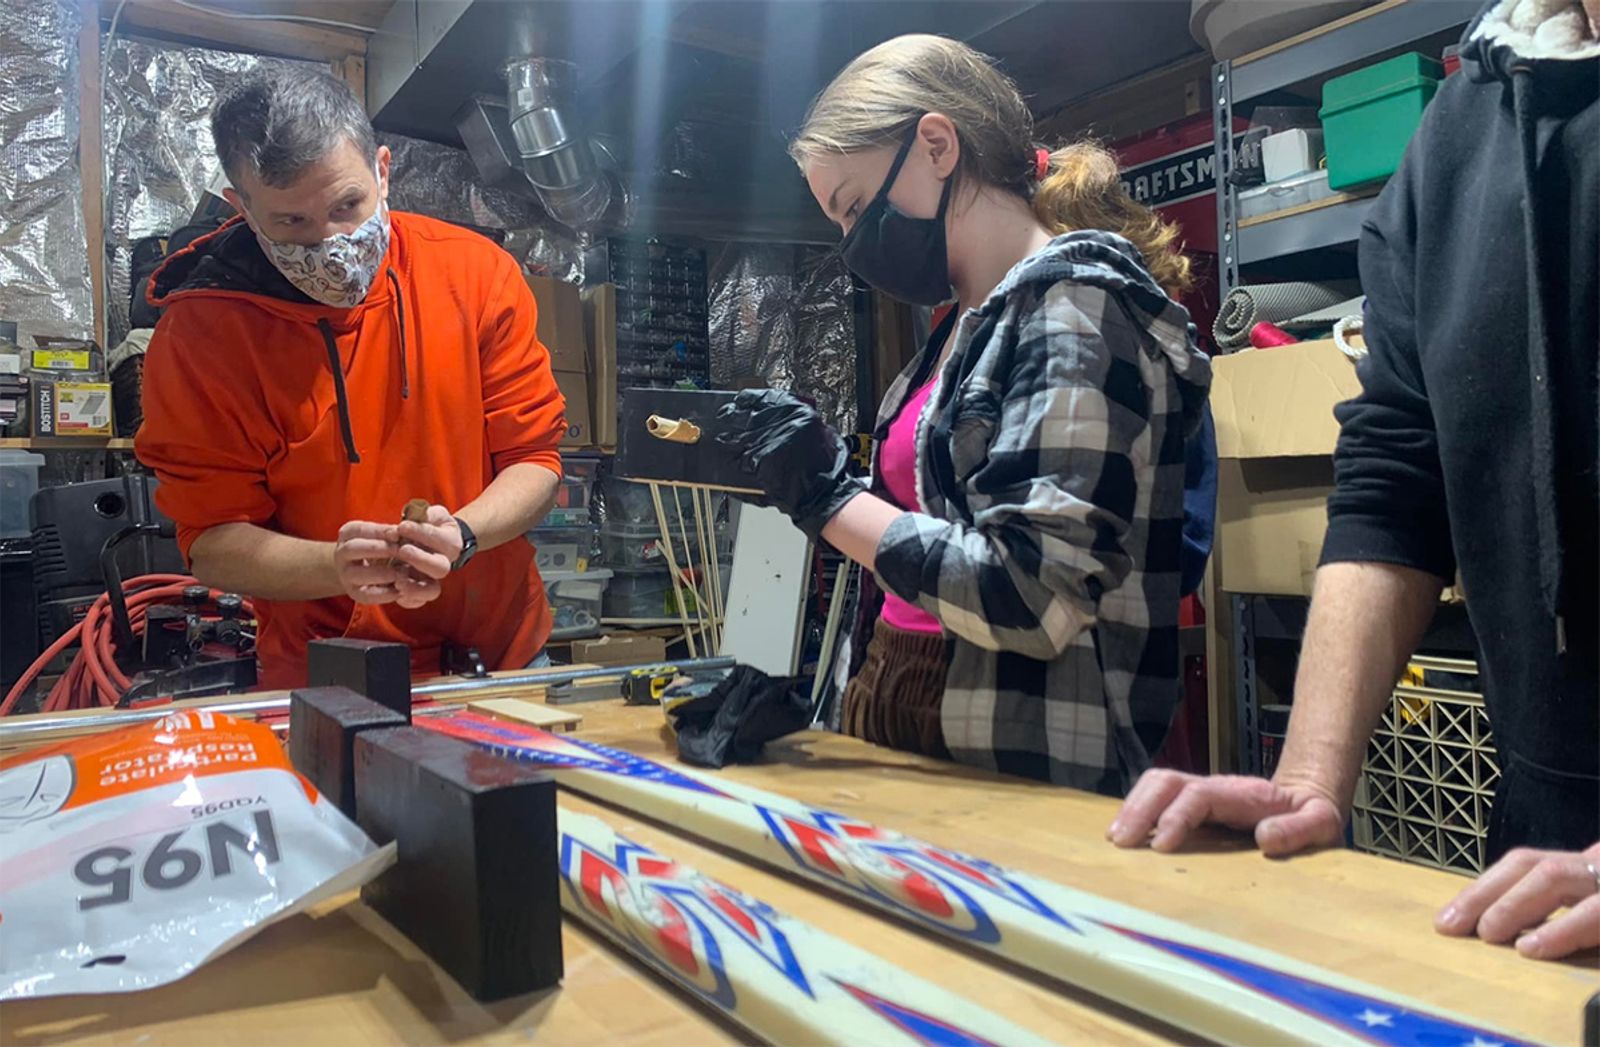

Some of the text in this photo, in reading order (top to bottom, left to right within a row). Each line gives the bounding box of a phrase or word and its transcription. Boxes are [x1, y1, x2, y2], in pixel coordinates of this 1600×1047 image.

[1118, 142, 1260, 201] RAFTSMN
[100, 742, 255, 775] Respator
[74, 809, 282, 912] N95
